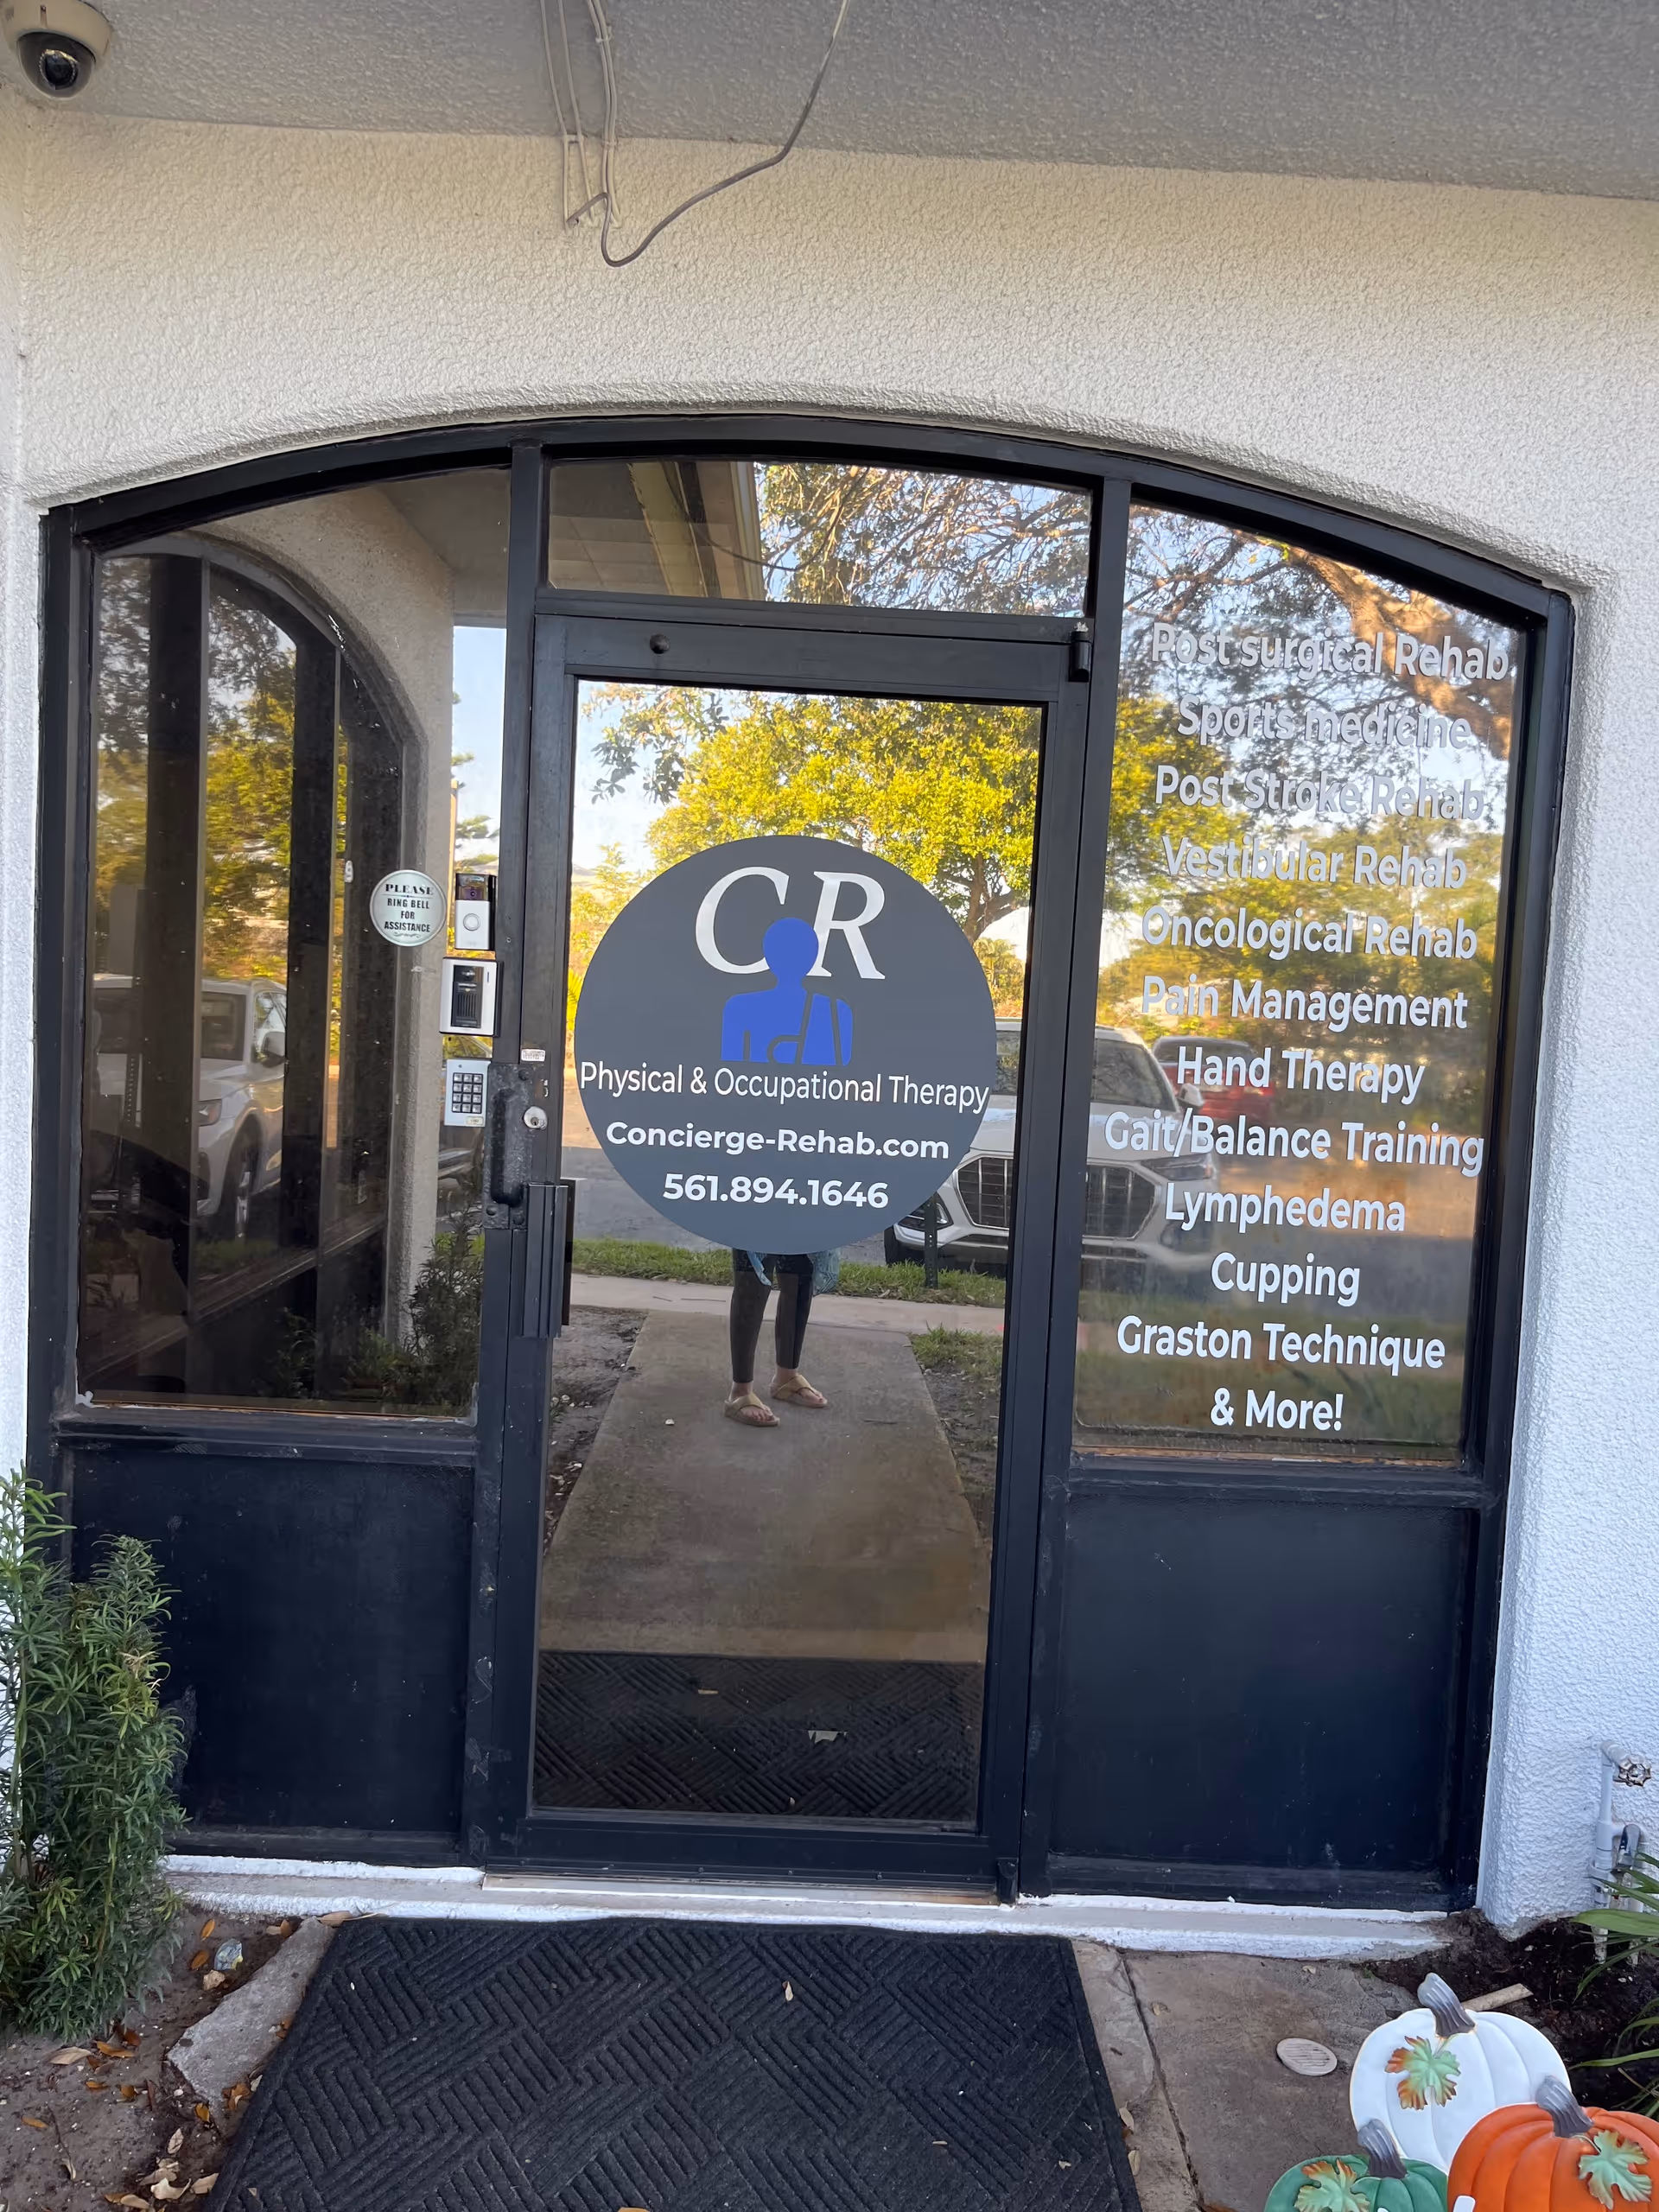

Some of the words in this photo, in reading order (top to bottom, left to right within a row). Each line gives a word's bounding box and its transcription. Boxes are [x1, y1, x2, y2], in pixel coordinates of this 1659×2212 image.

[1152, 622, 1230, 666] Post
[1240, 628, 1383, 680] surgical
[1395, 634, 1510, 681] Rehab
[1177, 694, 1294, 746] Sports
[1304, 702, 1471, 749] medicine
[1155, 765, 1233, 807] Post
[1244, 769, 1360, 813] Stroke
[1370, 776, 1484, 820] Rehab
[1162, 835, 1344, 882] Vestibular
[1354, 845, 1467, 889] Rehab
[385, 884, 433, 895] PLEASE
[387, 898, 408, 907] RING
[411, 900, 429, 909] BELL
[401, 911, 415, 919] FOR
[385, 921, 430, 932] ASSISTANCE
[1142, 905, 1354, 961] Oncological
[1365, 916, 1478, 959] Rehab
[1142, 974, 1219, 1017] Pain
[1231, 979, 1467, 1033] Management
[580, 1061, 683, 1098] Physical
[690, 1067, 708, 1095] &
[714, 1067, 880, 1104] Occupational
[889, 1075, 989, 1115] Therapy
[1177, 1046, 1271, 1089] Hand
[1281, 1050, 1425, 1104] Therapy
[606, 1122, 950, 1160] Concierge-Rehab.com
[1104, 1108, 1332, 1160] Gait/Balance
[1341, 1120, 1484, 1177] Training
[663, 1173, 888, 1209] 561.894.1646
[1165, 1183, 1405, 1234] Lymphedema
[1211, 1252, 1360, 1306] Cupping
[1116, 1315, 1251, 1360] Graston
[1262, 1322, 1446, 1376] Technique
[1211, 1387, 1235, 1427] &
[1245, 1389, 1344, 1431] More!
